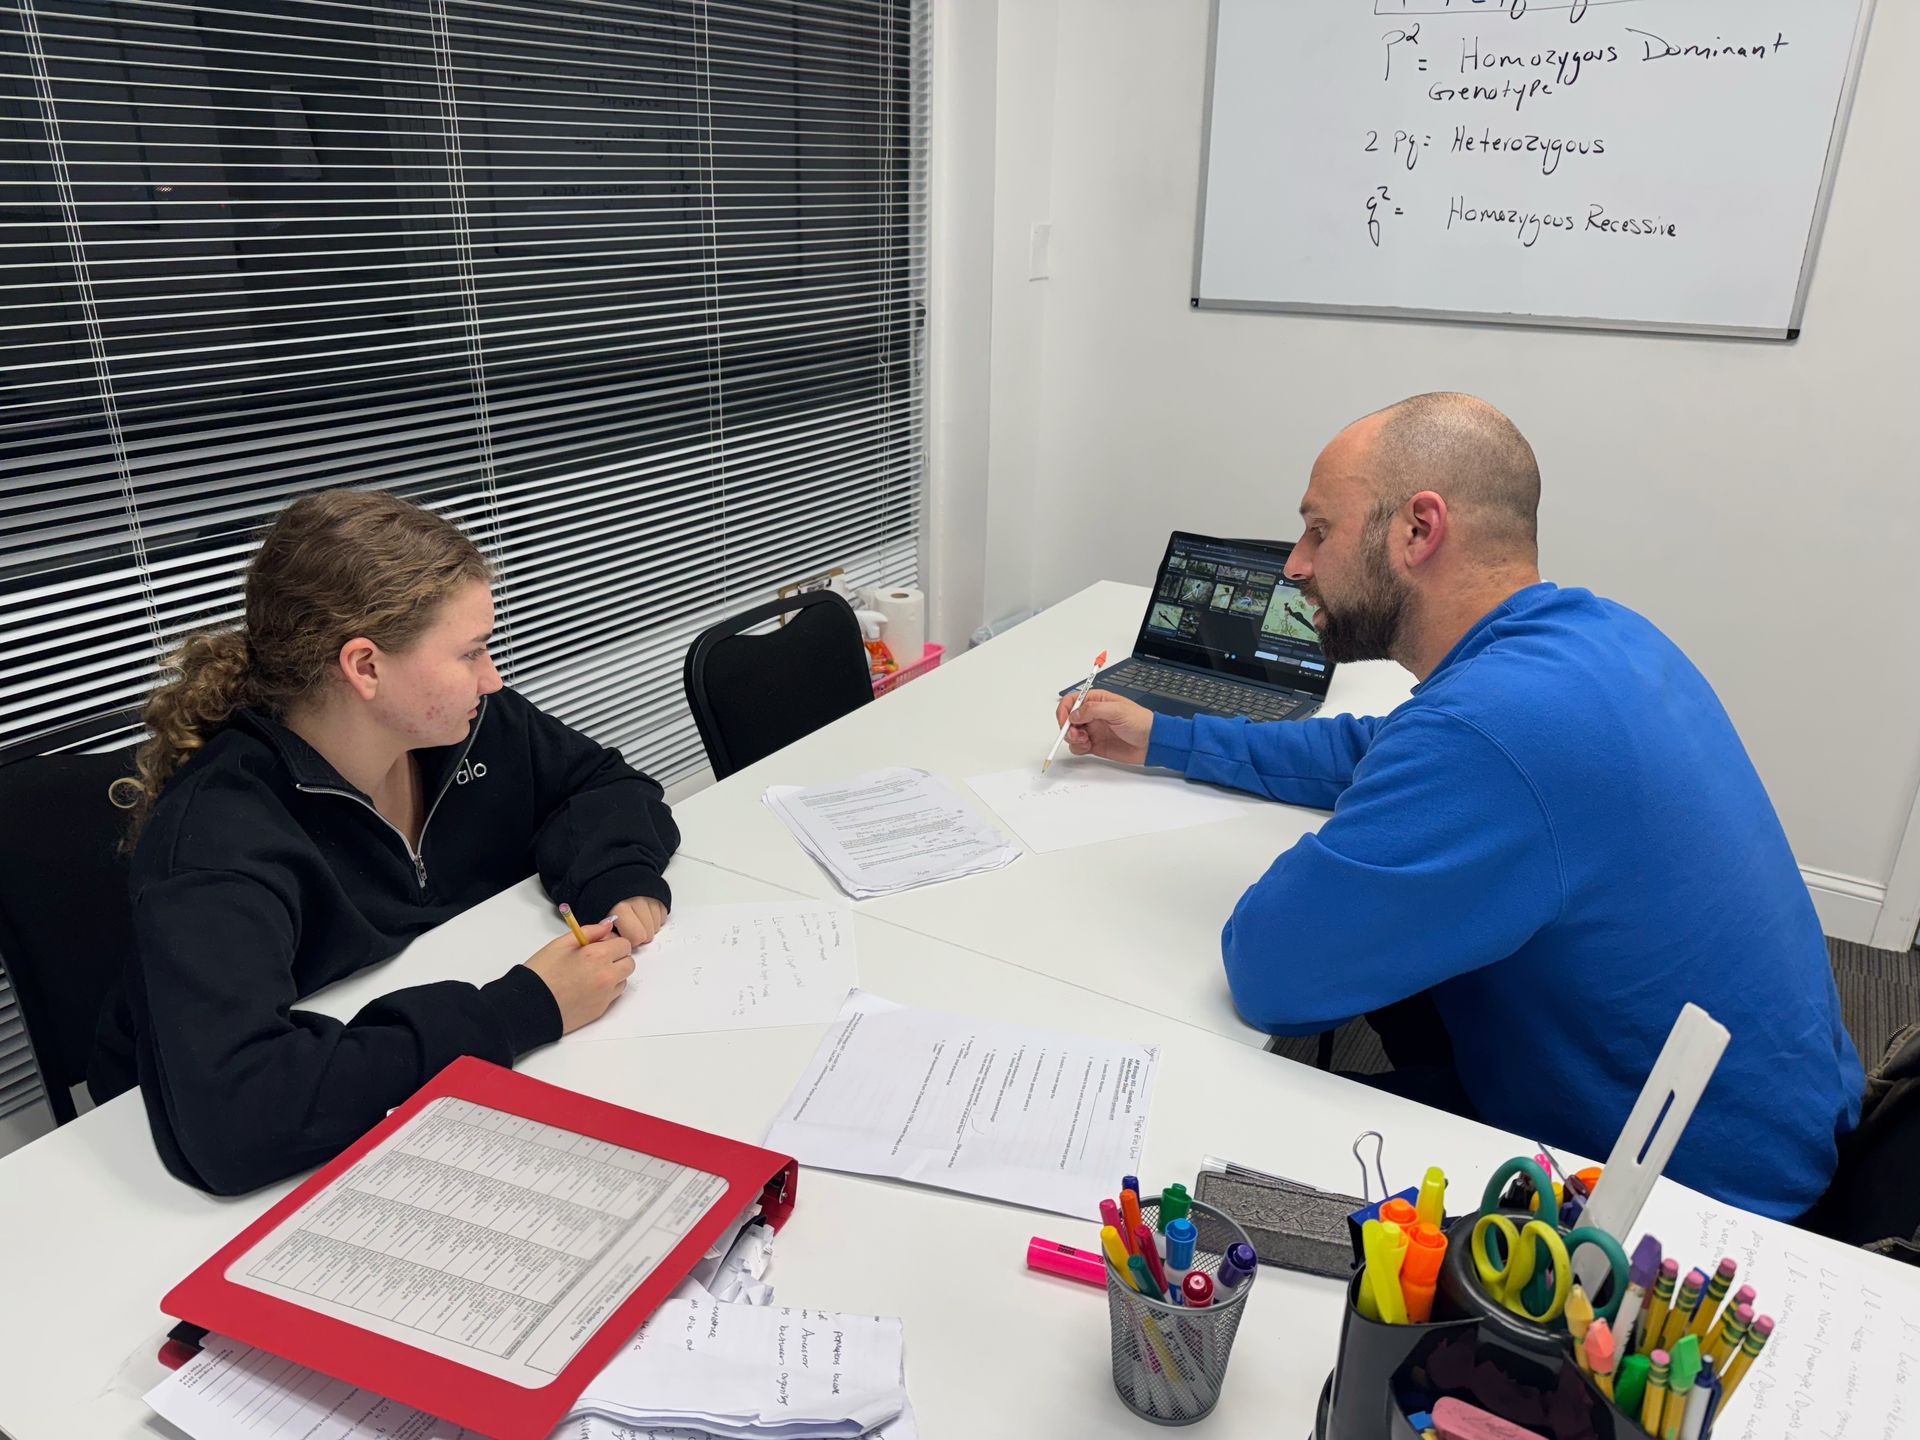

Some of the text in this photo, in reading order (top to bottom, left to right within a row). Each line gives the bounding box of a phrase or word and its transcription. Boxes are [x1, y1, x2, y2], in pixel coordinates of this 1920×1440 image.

[1624, 27, 1790, 62] Dominant
[1429, 79, 1553, 111] Genotype
[1365, 131, 1379, 152] 2
[1451, 125, 1605, 175] Heterozygous
[1447, 196, 1574, 247] Homozygous
[1585, 203, 1677, 238] Recessive
[456, 758, 487, 785] alo
[801, 1327, 816, 1369] Ancestor
